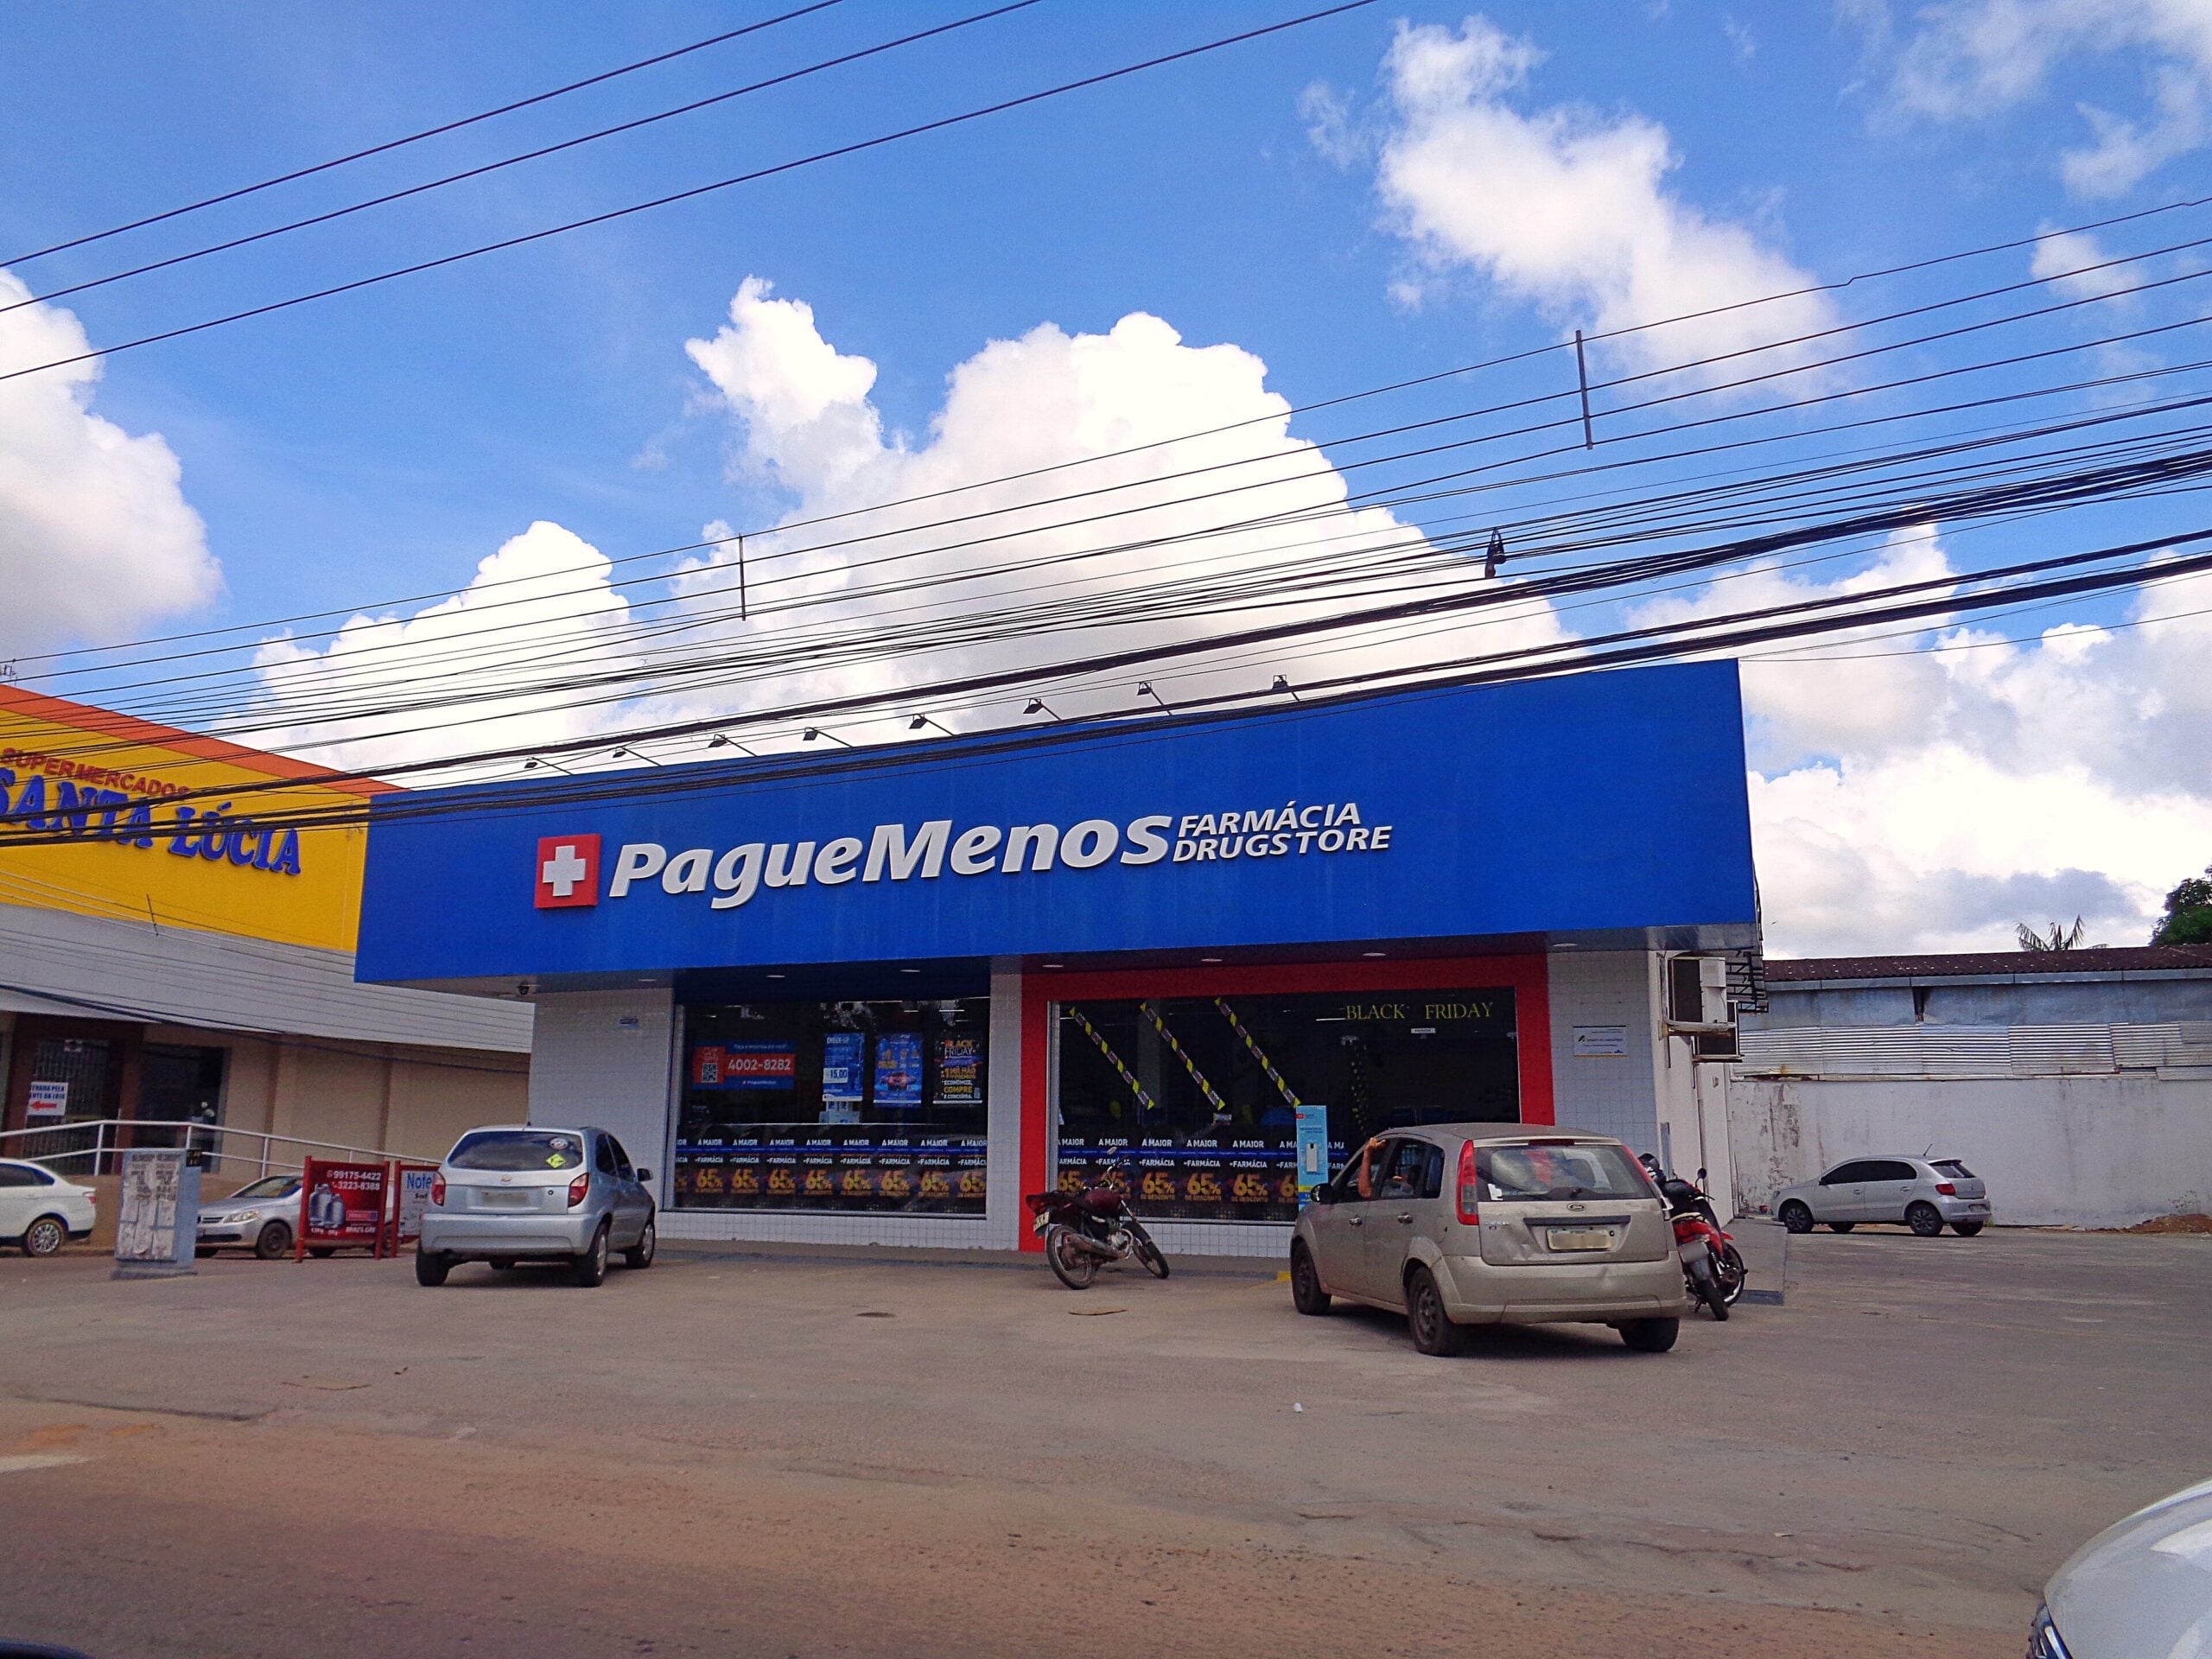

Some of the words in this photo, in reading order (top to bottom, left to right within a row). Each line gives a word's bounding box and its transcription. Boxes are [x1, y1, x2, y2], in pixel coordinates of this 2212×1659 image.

[1179, 800, 1361, 838] FARMÁCIA
[168, 801, 301, 875] LÚCIA
[1173, 826, 1393, 862] DRUGSTORE
[608, 815, 1173, 909] PagueMenos
[1346, 1003, 1406, 1020] BLACK
[1425, 1001, 1493, 1020] FRIDAY
[728, 1059, 791, 1071] 4002-8282
[334, 1170, 381, 1181] 99175-4422
